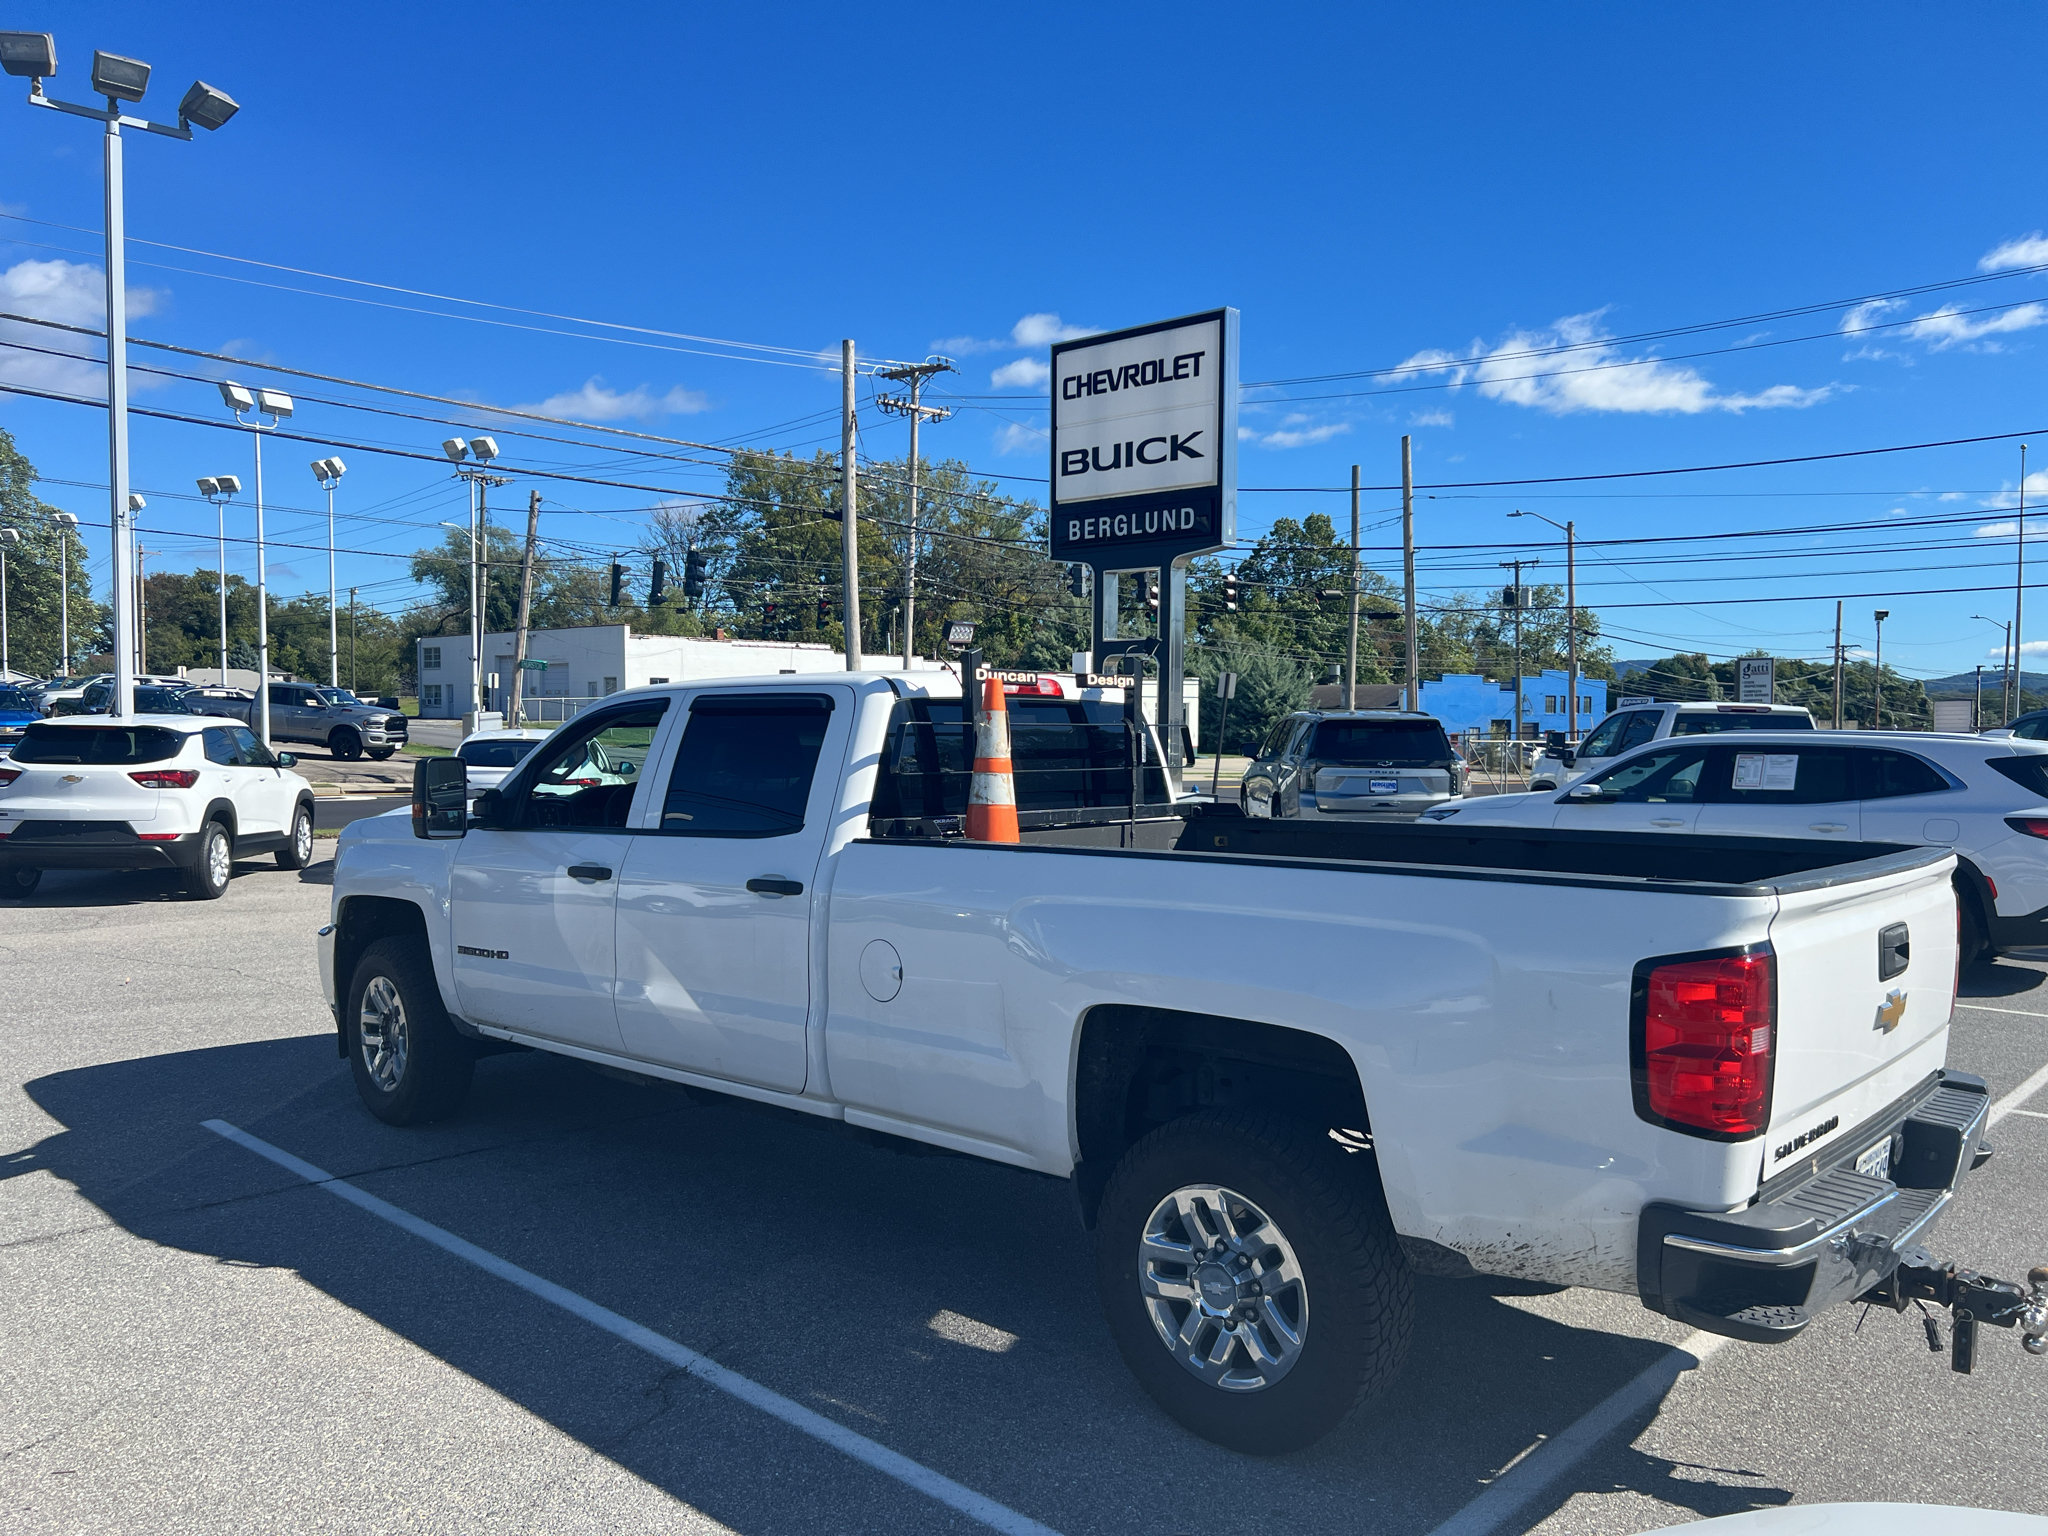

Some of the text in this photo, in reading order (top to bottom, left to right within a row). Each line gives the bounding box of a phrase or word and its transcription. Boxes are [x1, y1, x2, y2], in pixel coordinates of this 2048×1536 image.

[1062, 351, 1206, 400] CHEVROLET
[1061, 430, 1205, 477] BUICK
[1068, 507, 1195, 541] BERGLUND
[975, 668, 1135, 688] Duncan Design
[1742, 663, 1769, 679] gatti
[1774, 1115, 1839, 1163] SILVERADO
